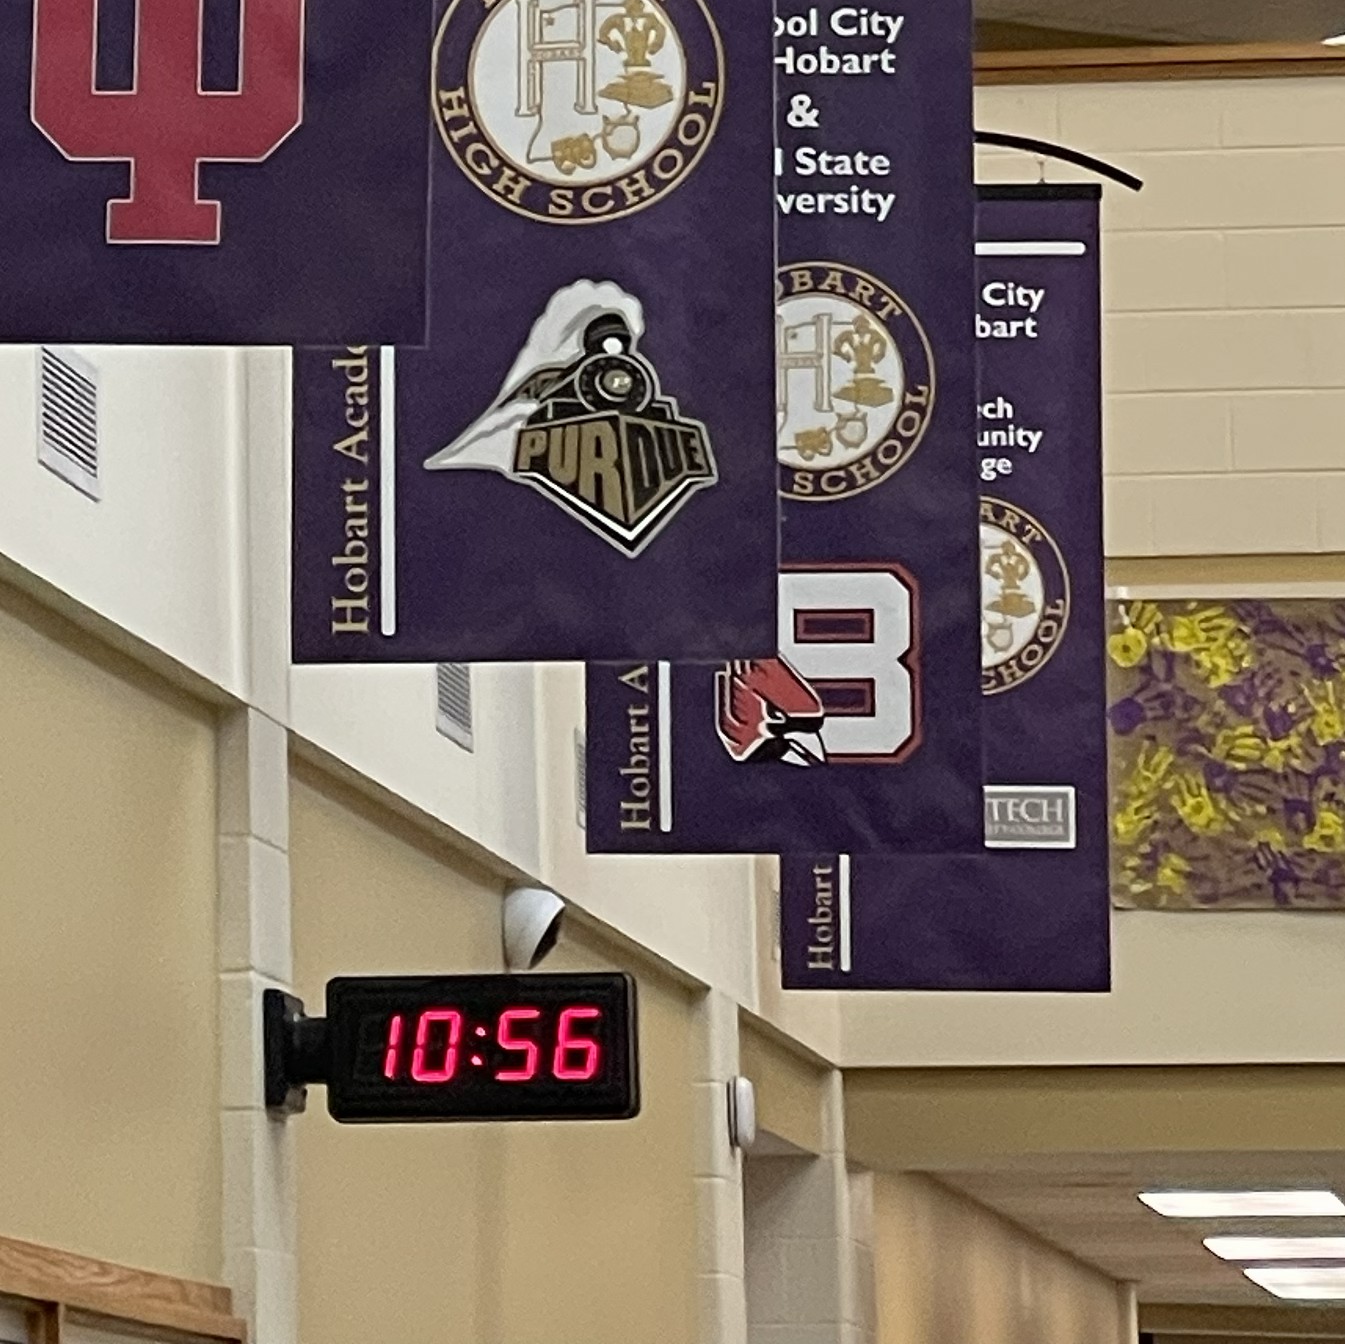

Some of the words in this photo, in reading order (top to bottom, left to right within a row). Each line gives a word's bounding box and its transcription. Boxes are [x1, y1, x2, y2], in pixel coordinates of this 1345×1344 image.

[830, 7, 905, 44] City
[439, 86, 532, 205] HIGH
[548, 81, 716, 206] SCHOOL
[786, 93, 820, 128] &
[795, 146, 891, 176] State
[981, 281, 1046, 313] City
[516, 418, 707, 522] PURDUE
[792, 384, 929, 495] SCHOOL
[331, 479, 369, 634] Hobart
[619, 705, 651, 829] Hobart
[986, 798, 1064, 823] TECH
[806, 862, 835, 972] Hobart
[384, 1008, 600, 1082] 10:56
